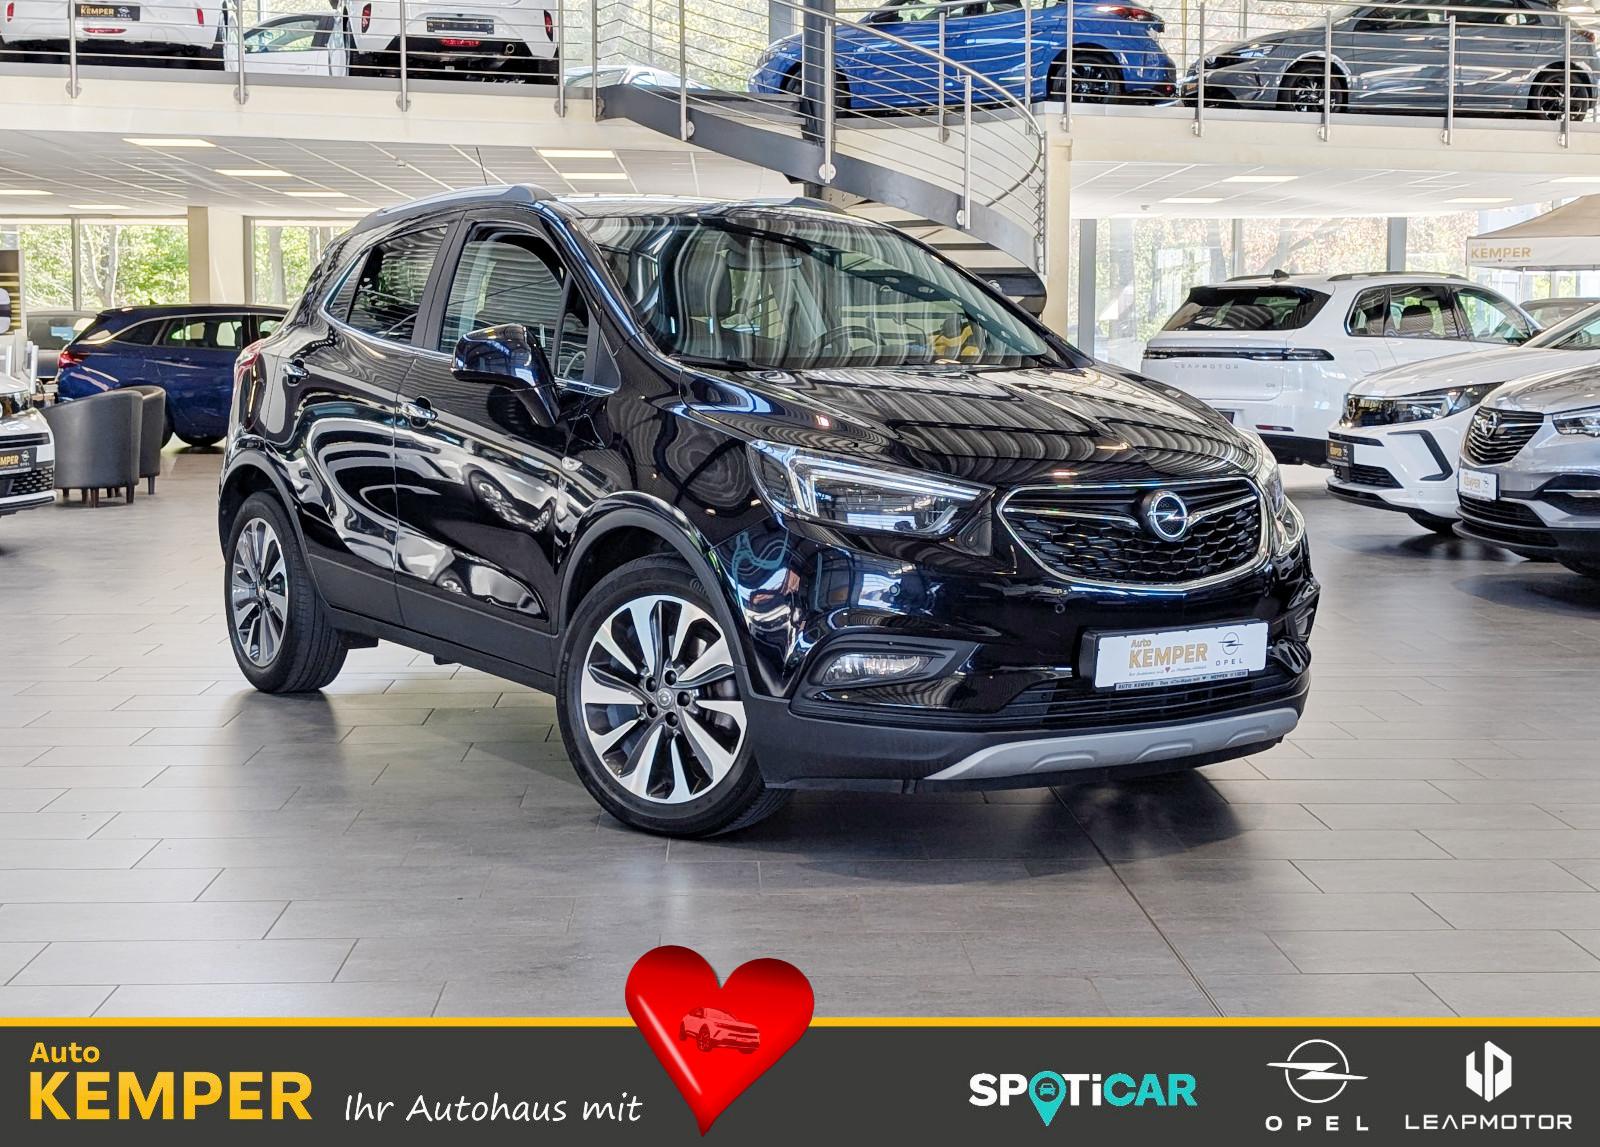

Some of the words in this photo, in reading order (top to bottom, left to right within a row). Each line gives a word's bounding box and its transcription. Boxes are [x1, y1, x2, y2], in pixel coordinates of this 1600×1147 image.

[1471, 247, 1532, 258] KEMPER
[1131, 639, 1152, 648] Auto
[1128, 643, 1208, 669] KEMPER
[1216, 658, 1243, 666] OPEL
